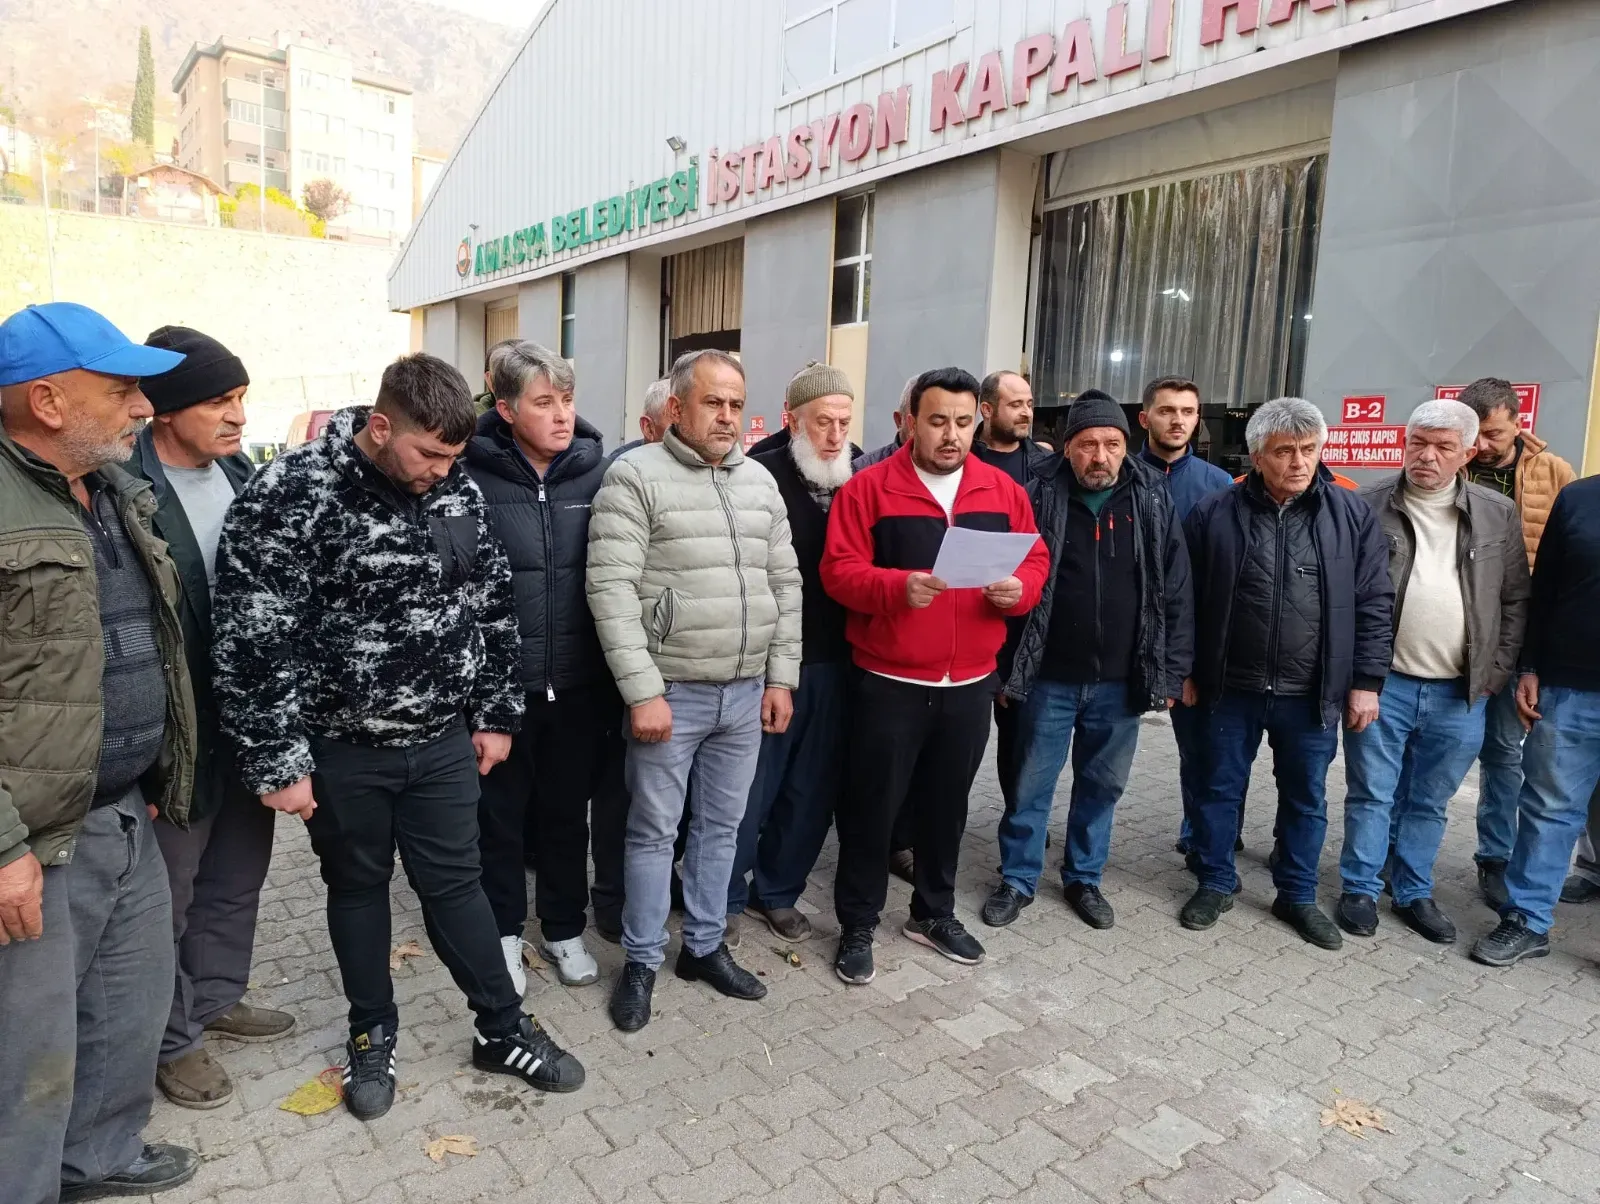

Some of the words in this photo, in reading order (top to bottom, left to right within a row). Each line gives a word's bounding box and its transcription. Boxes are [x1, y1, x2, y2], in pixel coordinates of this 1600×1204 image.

[474, 221, 549, 276] AMASYA
[552, 155, 699, 252] BELEDİYESİ
[707, 84, 912, 205] İSTASYON
[930, 0, 1175, 132] KAPALI
[1345, 402, 1382, 418] B-2
[1328, 430, 1348, 445] ARAÇ
[1350, 430, 1370, 446] ÇIKIŞ
[1372, 430, 1398, 444] KAPISI
[1322, 445, 1348, 463] GİRİŞ
[1351, 447, 1402, 461] YASAKTIR
